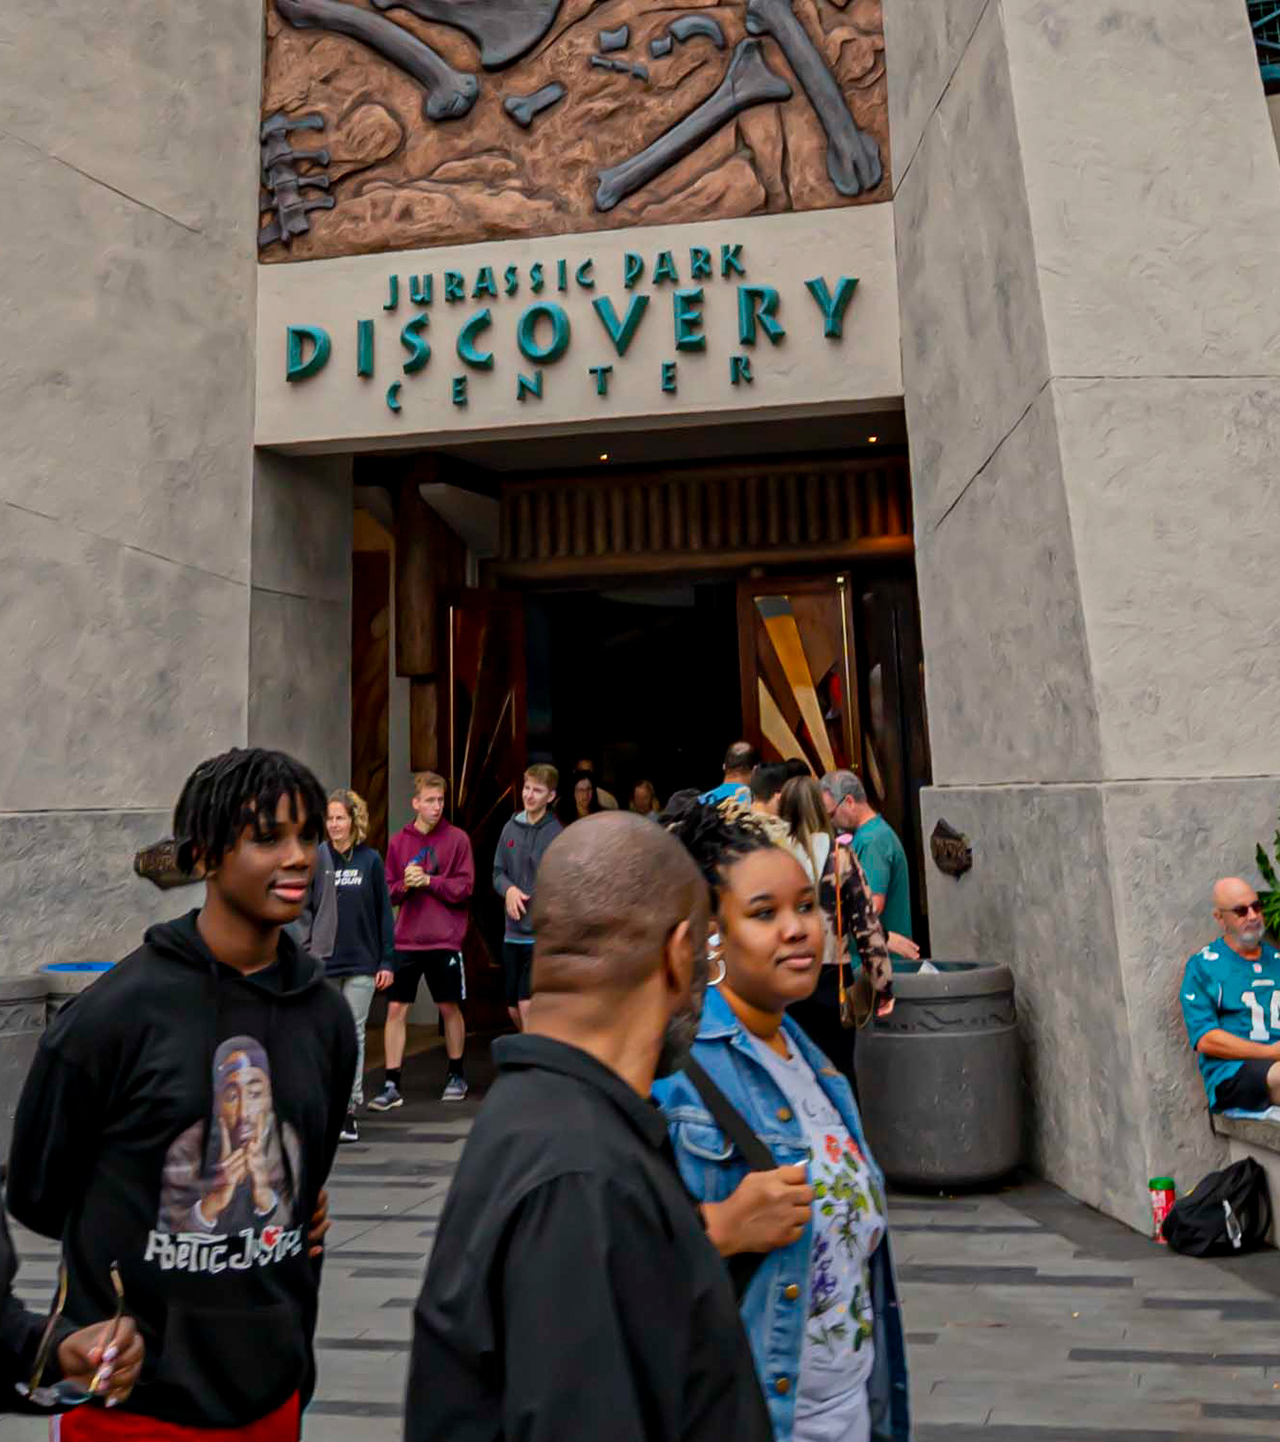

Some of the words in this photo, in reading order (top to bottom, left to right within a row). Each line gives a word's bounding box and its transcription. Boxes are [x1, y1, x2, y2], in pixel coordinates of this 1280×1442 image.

[383, 257, 596, 312] JURASSIC
[623, 243, 746, 289] PARK
[286, 275, 859, 382] DISCOVERY
[385, 354, 754, 413] CENTER
